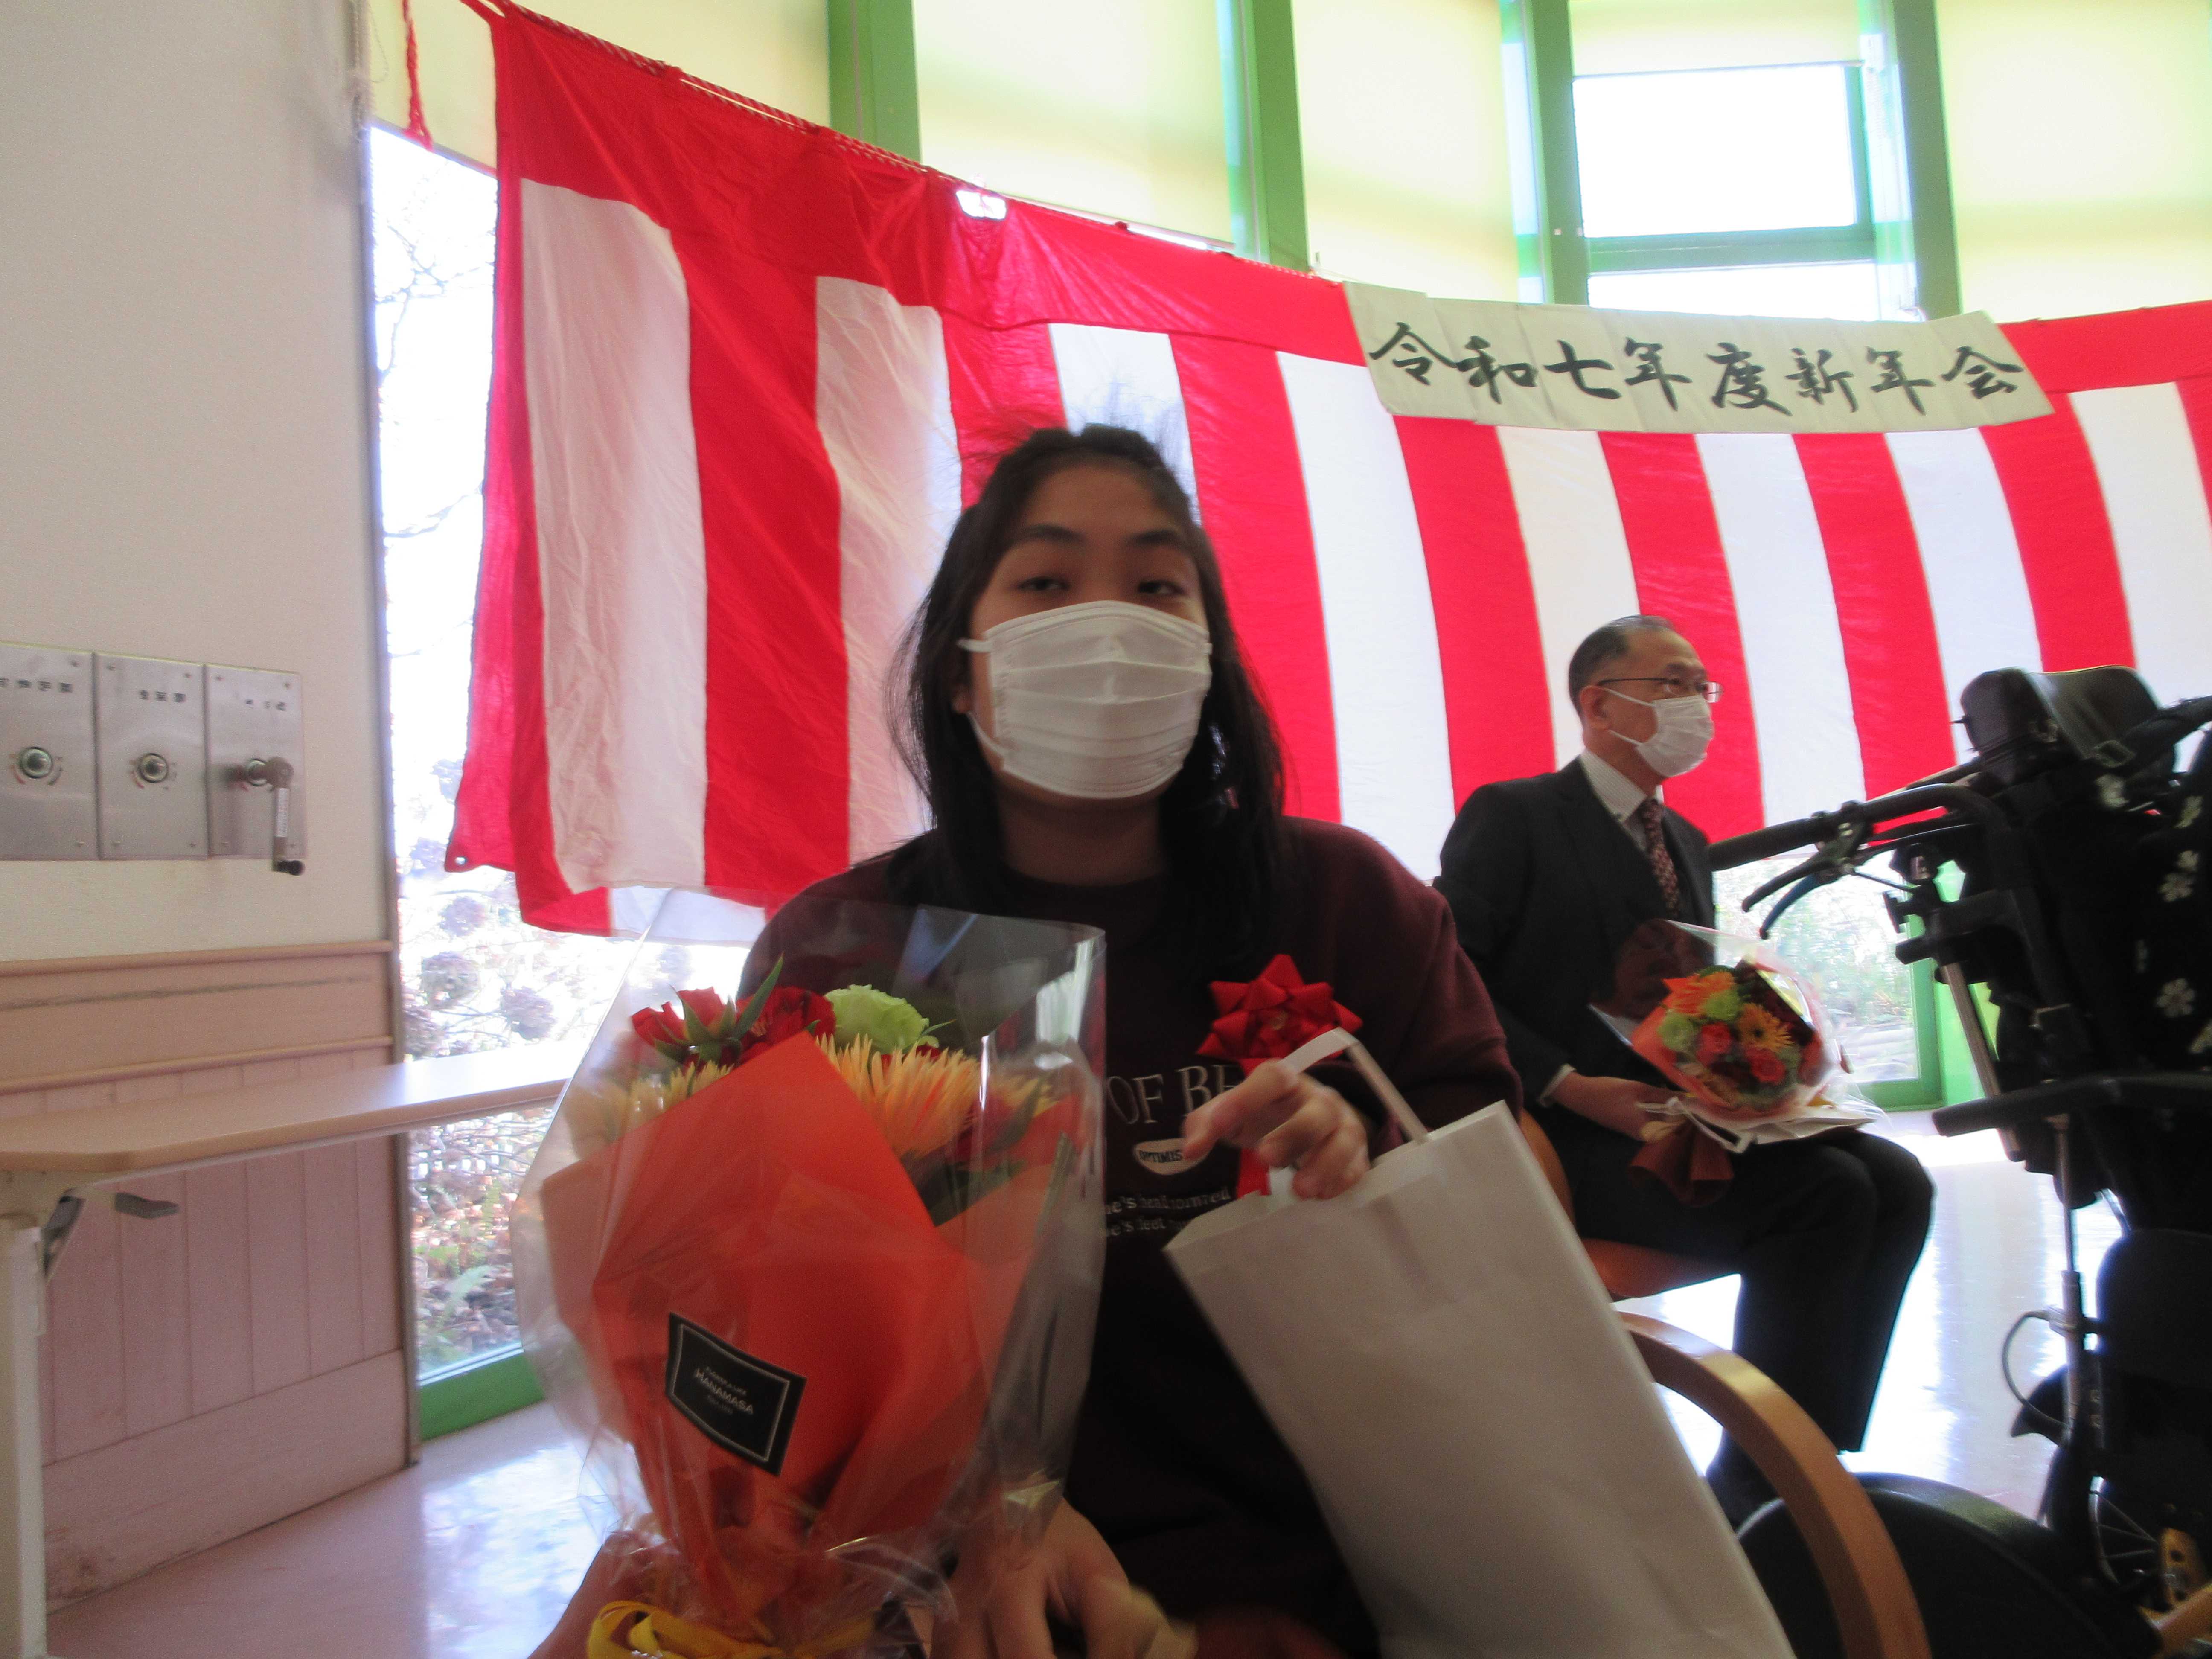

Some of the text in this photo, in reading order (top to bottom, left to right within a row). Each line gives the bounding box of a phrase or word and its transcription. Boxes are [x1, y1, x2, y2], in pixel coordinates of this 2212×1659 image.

[1369, 322, 2024, 416] 令和七年度新年会
[1106, 1065, 1242, 1124] OF BE
[1139, 1149, 1182, 1163] OPTIMIS
